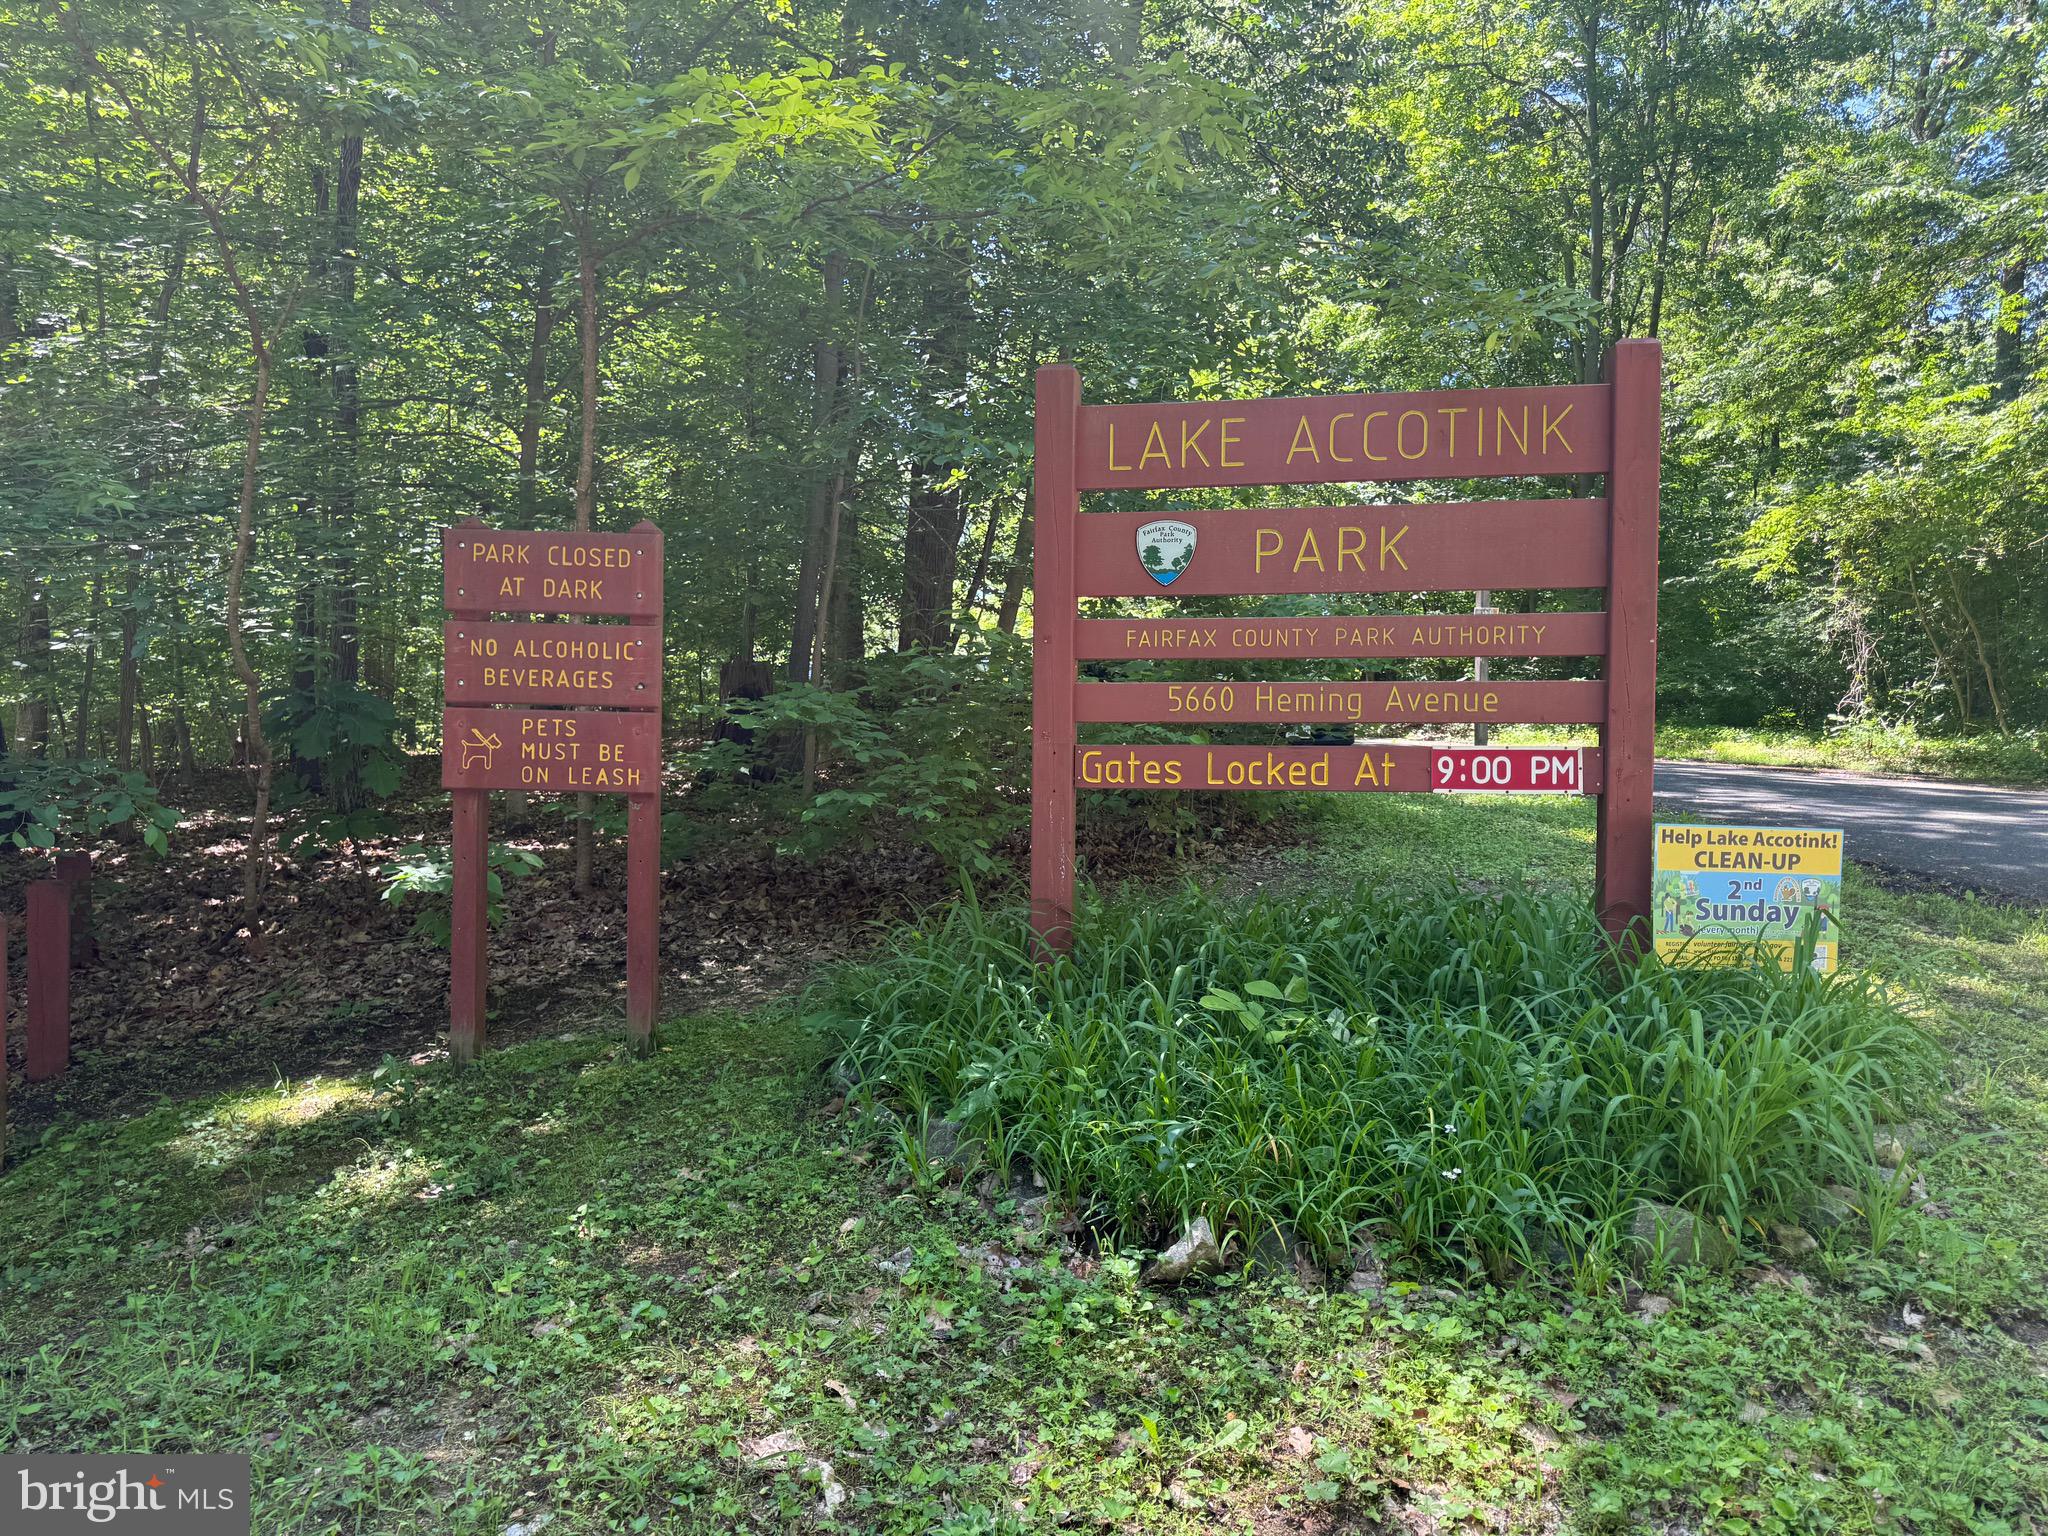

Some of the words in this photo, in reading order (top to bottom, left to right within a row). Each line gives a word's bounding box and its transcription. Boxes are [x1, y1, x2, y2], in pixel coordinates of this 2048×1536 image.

[1108, 417, 1247, 471] LAKE
[1285, 403, 1574, 465] ACCOTINK
[1142, 526, 1165, 536] Fairfax
[1168, 525, 1193, 537] County
[472, 543, 531, 565] PARK
[547, 545, 632, 568] CLOSED
[1254, 525, 1409, 573] PARK
[499, 577, 525, 597] AT
[543, 578, 603, 600] DARK
[1126, 629, 1217, 648] FAIRFAX
[1232, 627, 1319, 647] COUNTY
[1335, 627, 1395, 646] PARK
[1411, 625, 1546, 646] AUTHORITY
[470, 638, 498, 657] NO
[513, 639, 635, 661] ALCOHOLIC
[483, 668, 614, 689] BEVERAGES
[1168, 685, 1234, 713] 5660
[1255, 685, 1362, 720] Heming
[1385, 685, 1498, 713] Avenue
[522, 718, 577, 737] PETS
[521, 743, 581, 761] MUST
[599, 744, 625, 763] BE
[521, 766, 549, 784] ON
[568, 767, 640, 786] LEASH
[1082, 751, 1182, 784] Gates
[1207, 751, 1329, 786] Locked
[1354, 752, 1396, 786] At
[1437, 755, 1512, 785] 9:00
[1530, 755, 1575, 785] PM
[1661, 829, 1702, 848] Help
[1706, 830, 1748, 846] Lake
[1752, 832, 1837, 849] Accotink!
[1694, 851, 1801, 871] CLEAN-UP
[1727, 879, 1763, 900] 2nd
[1695, 897, 1800, 929] Sunday
